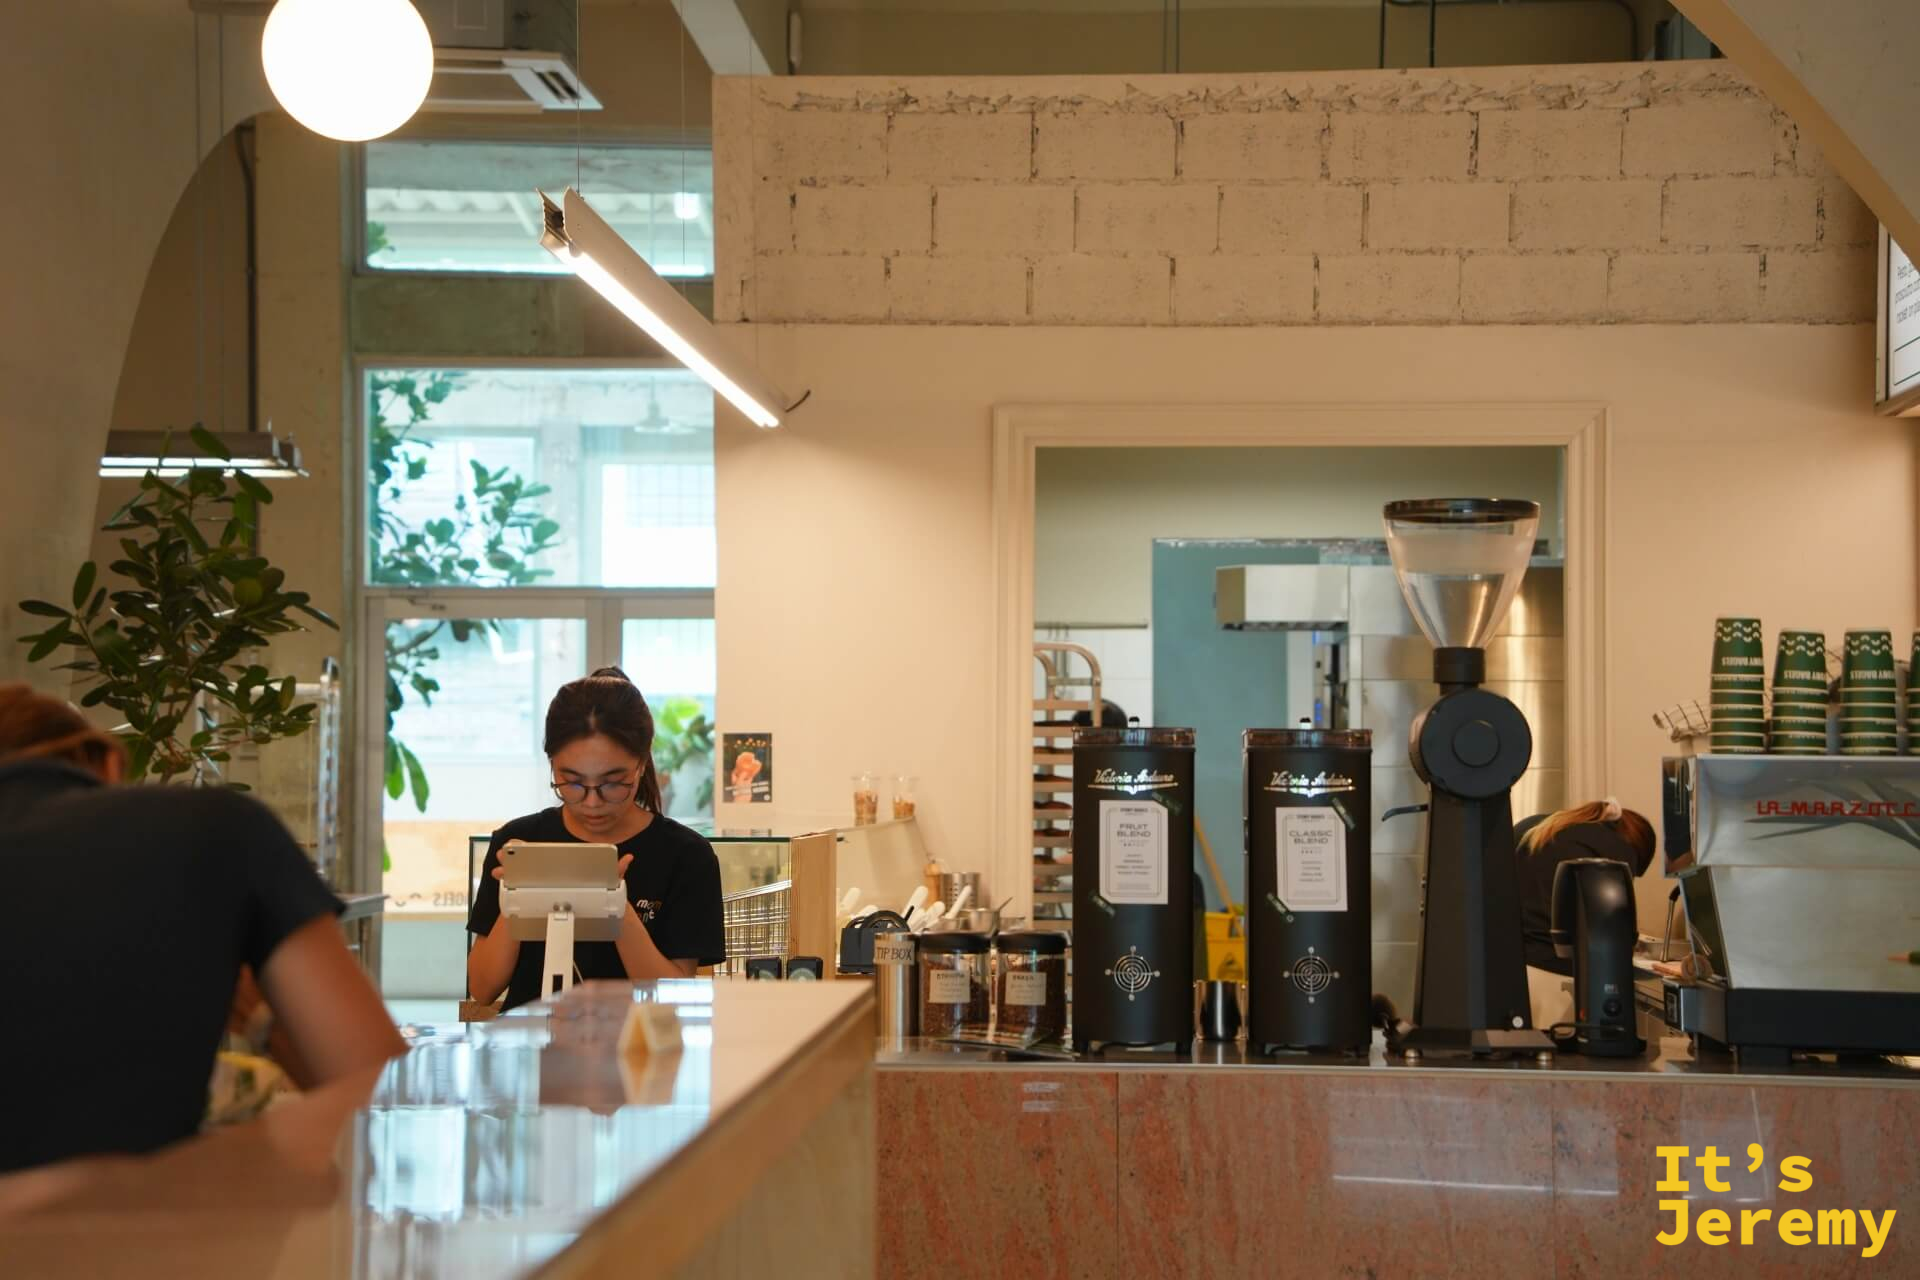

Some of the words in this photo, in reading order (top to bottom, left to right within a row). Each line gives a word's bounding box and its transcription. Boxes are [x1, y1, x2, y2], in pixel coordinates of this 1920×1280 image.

[1757, 800, 1780, 816] LA
[876, 946, 890, 960] TIP
[891, 947, 912, 961] BOX
